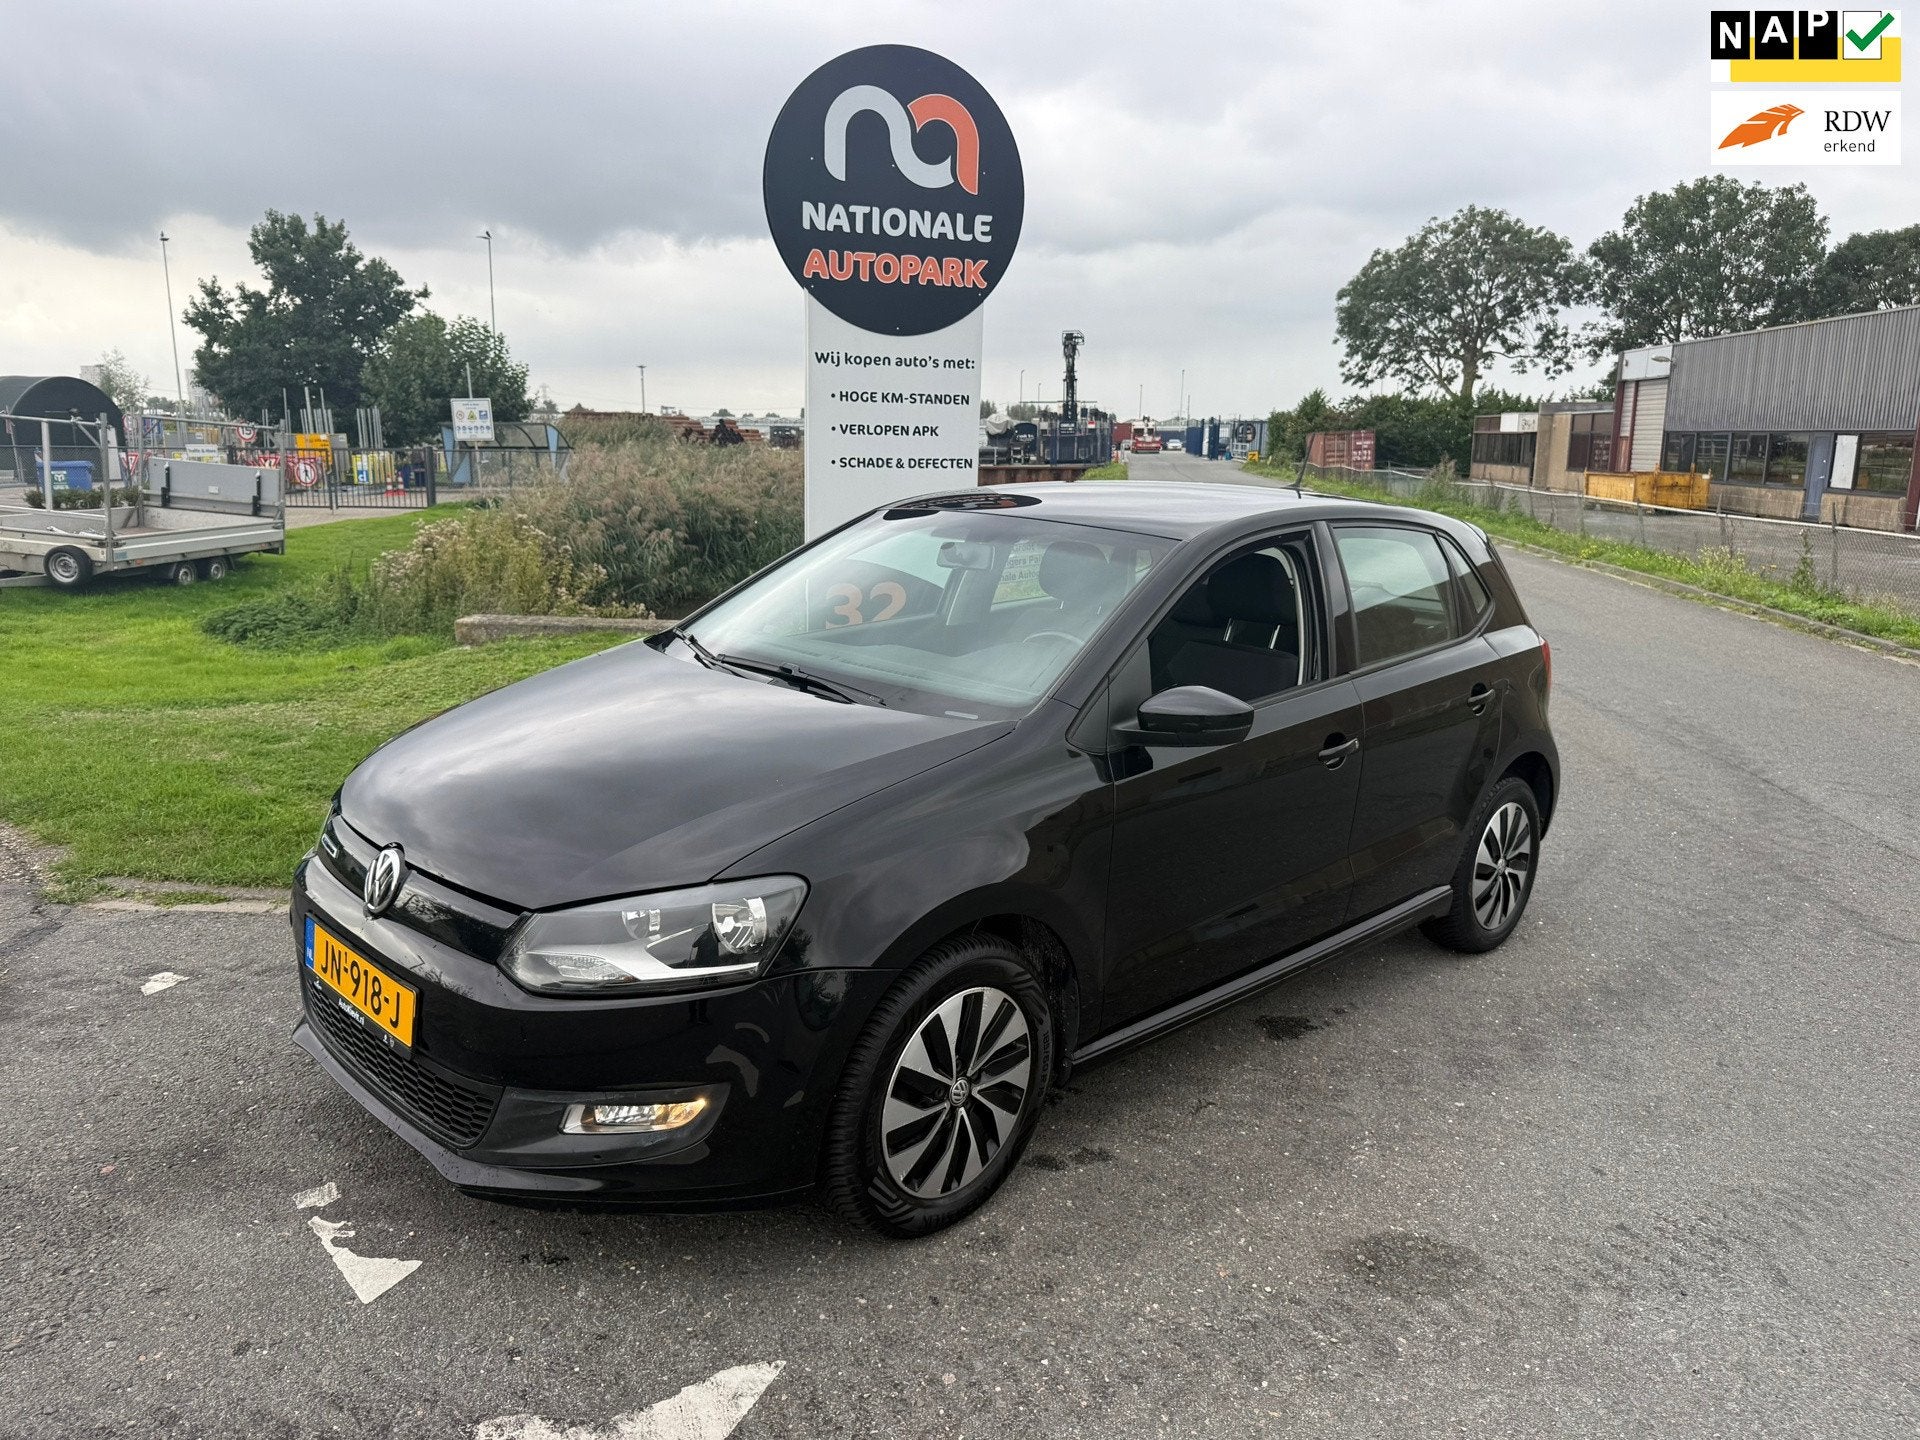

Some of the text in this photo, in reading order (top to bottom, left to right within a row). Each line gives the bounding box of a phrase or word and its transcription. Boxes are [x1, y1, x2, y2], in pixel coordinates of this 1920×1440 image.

[802, 201, 993, 243] NATIONALE
[803, 248, 989, 289] AUTOPARK
[814, 351, 976, 370] Wij kopen auto's met:
[839, 390, 970, 405] HOGE KM-STANDEN
[839, 423, 939, 437] VERLOPEN APK
[839, 457, 973, 469] SCHADE & DEFECTEN
[826, 582, 907, 630] 32
[320, 939, 400, 1029] JN-918-J
